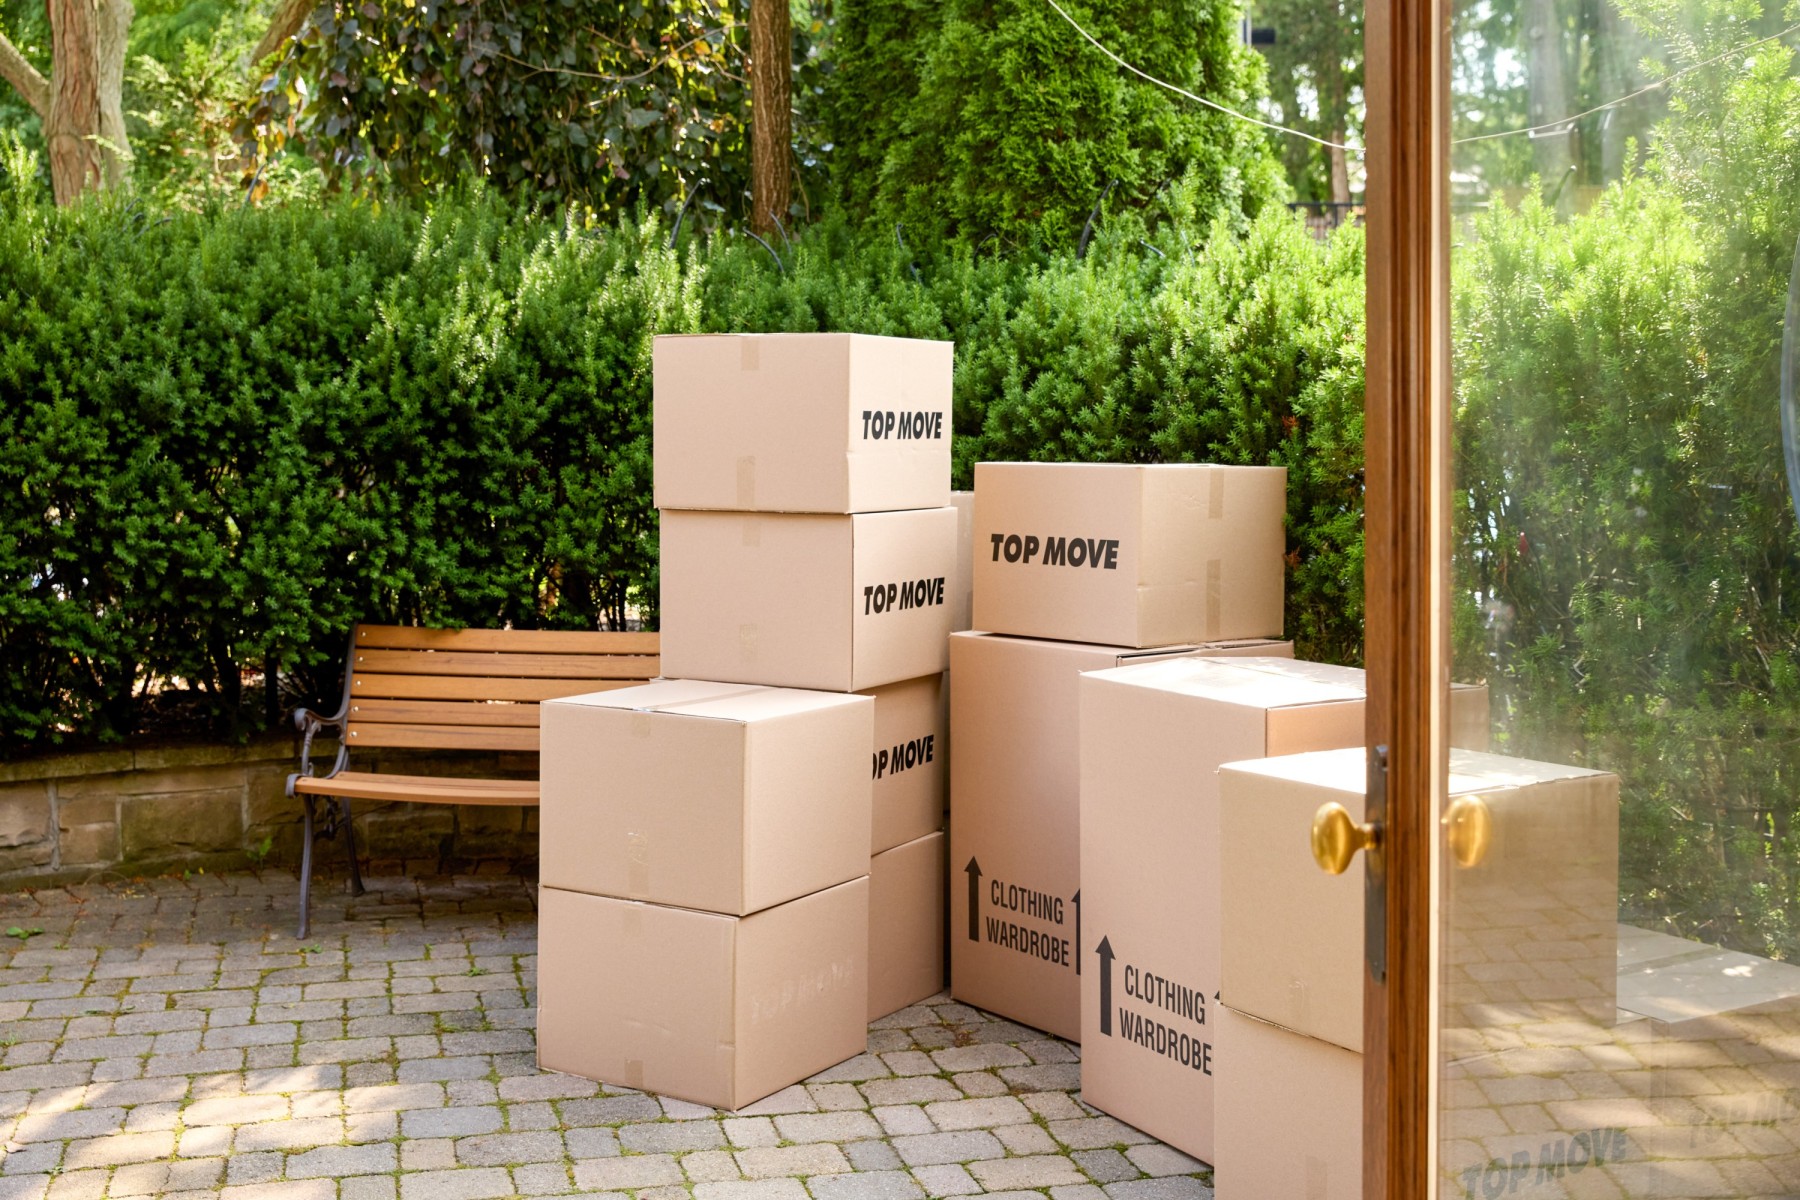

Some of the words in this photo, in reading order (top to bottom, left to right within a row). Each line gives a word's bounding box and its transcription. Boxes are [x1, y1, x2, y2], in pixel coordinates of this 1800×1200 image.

[862, 410, 896, 440] TOP
[897, 411, 943, 440] MOVE
[990, 533, 1040, 564] TOP
[1042, 536, 1120, 570] MOVE
[863, 583, 898, 616] TOP
[898, 576, 945, 611] MOVE
[889, 733, 935, 775] MOVE
[990, 879, 1064, 925] CLOTHING
[985, 916, 1070, 967] WARDROBE
[1124, 964, 1206, 1025] CLOTHING
[1119, 1007, 1212, 1077] WARDROBE
[1462, 1150, 1531, 1200] TOP
[1534, 1128, 1628, 1186] MOVE
